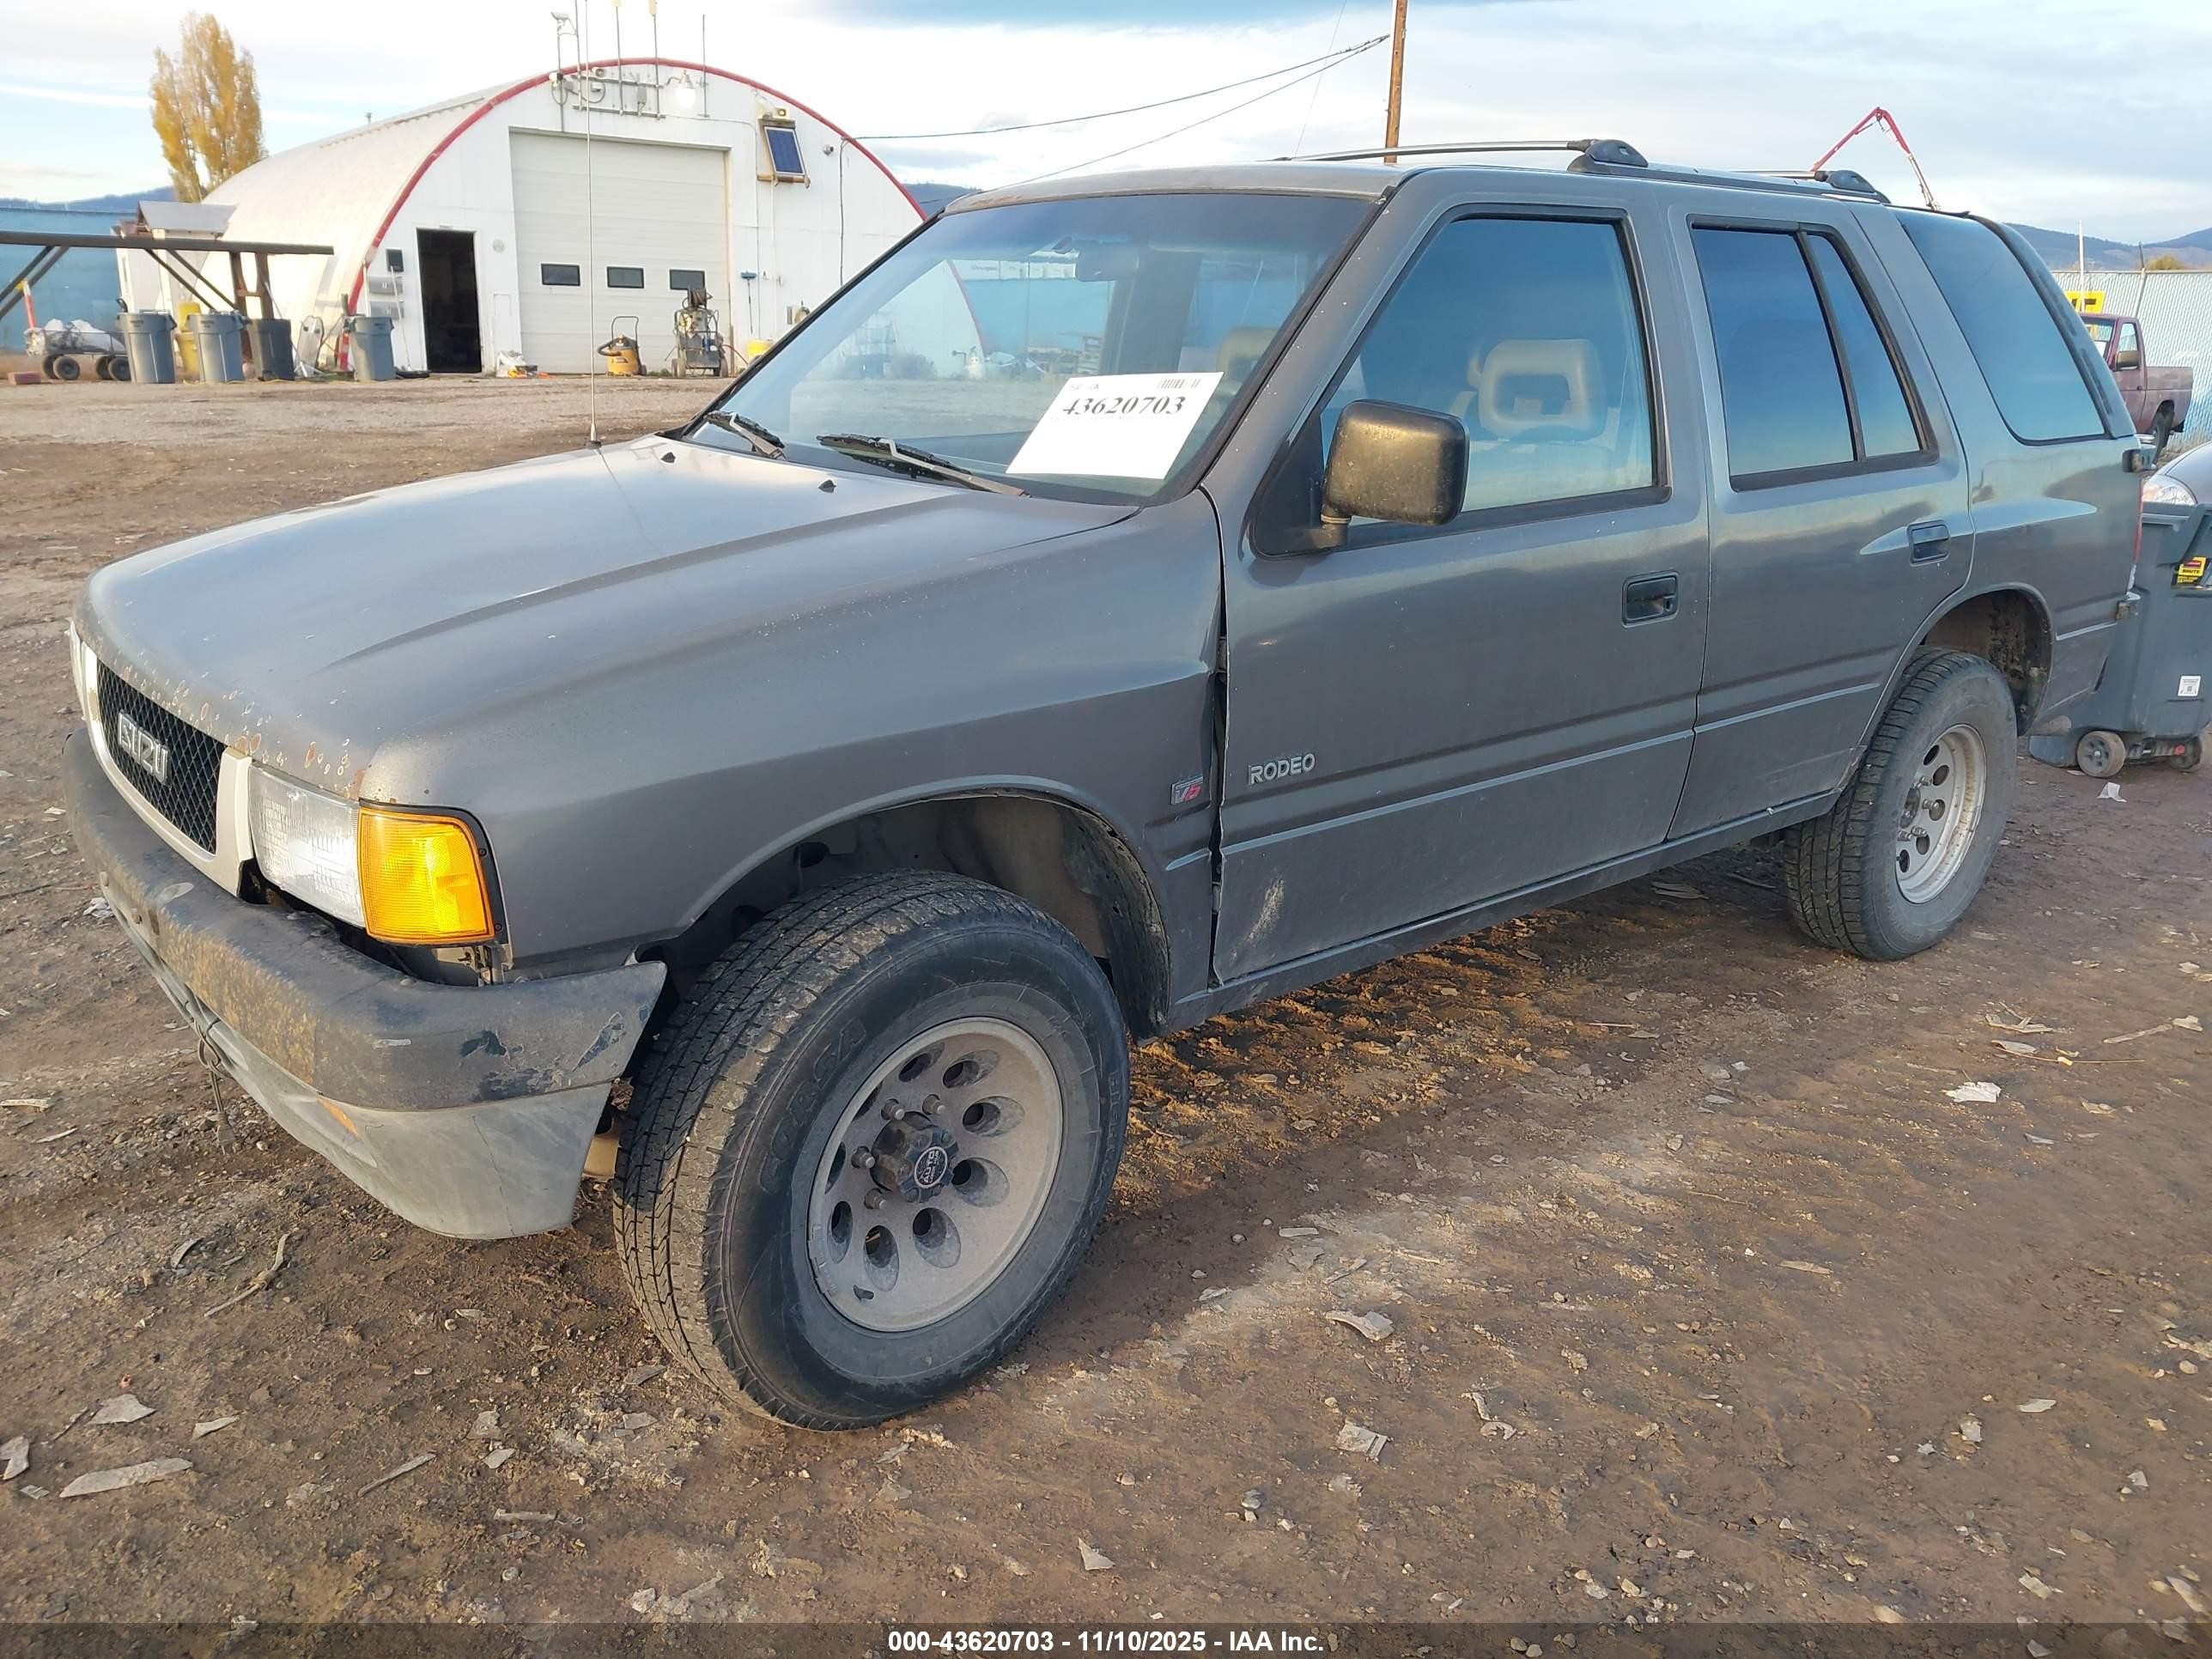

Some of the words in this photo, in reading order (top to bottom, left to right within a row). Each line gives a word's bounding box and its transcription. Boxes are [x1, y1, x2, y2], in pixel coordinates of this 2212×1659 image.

[1062, 396, 1187, 416] 43620703
[1248, 753, 1316, 785] RODEO
[922, 1151, 936, 1183] AUTO
